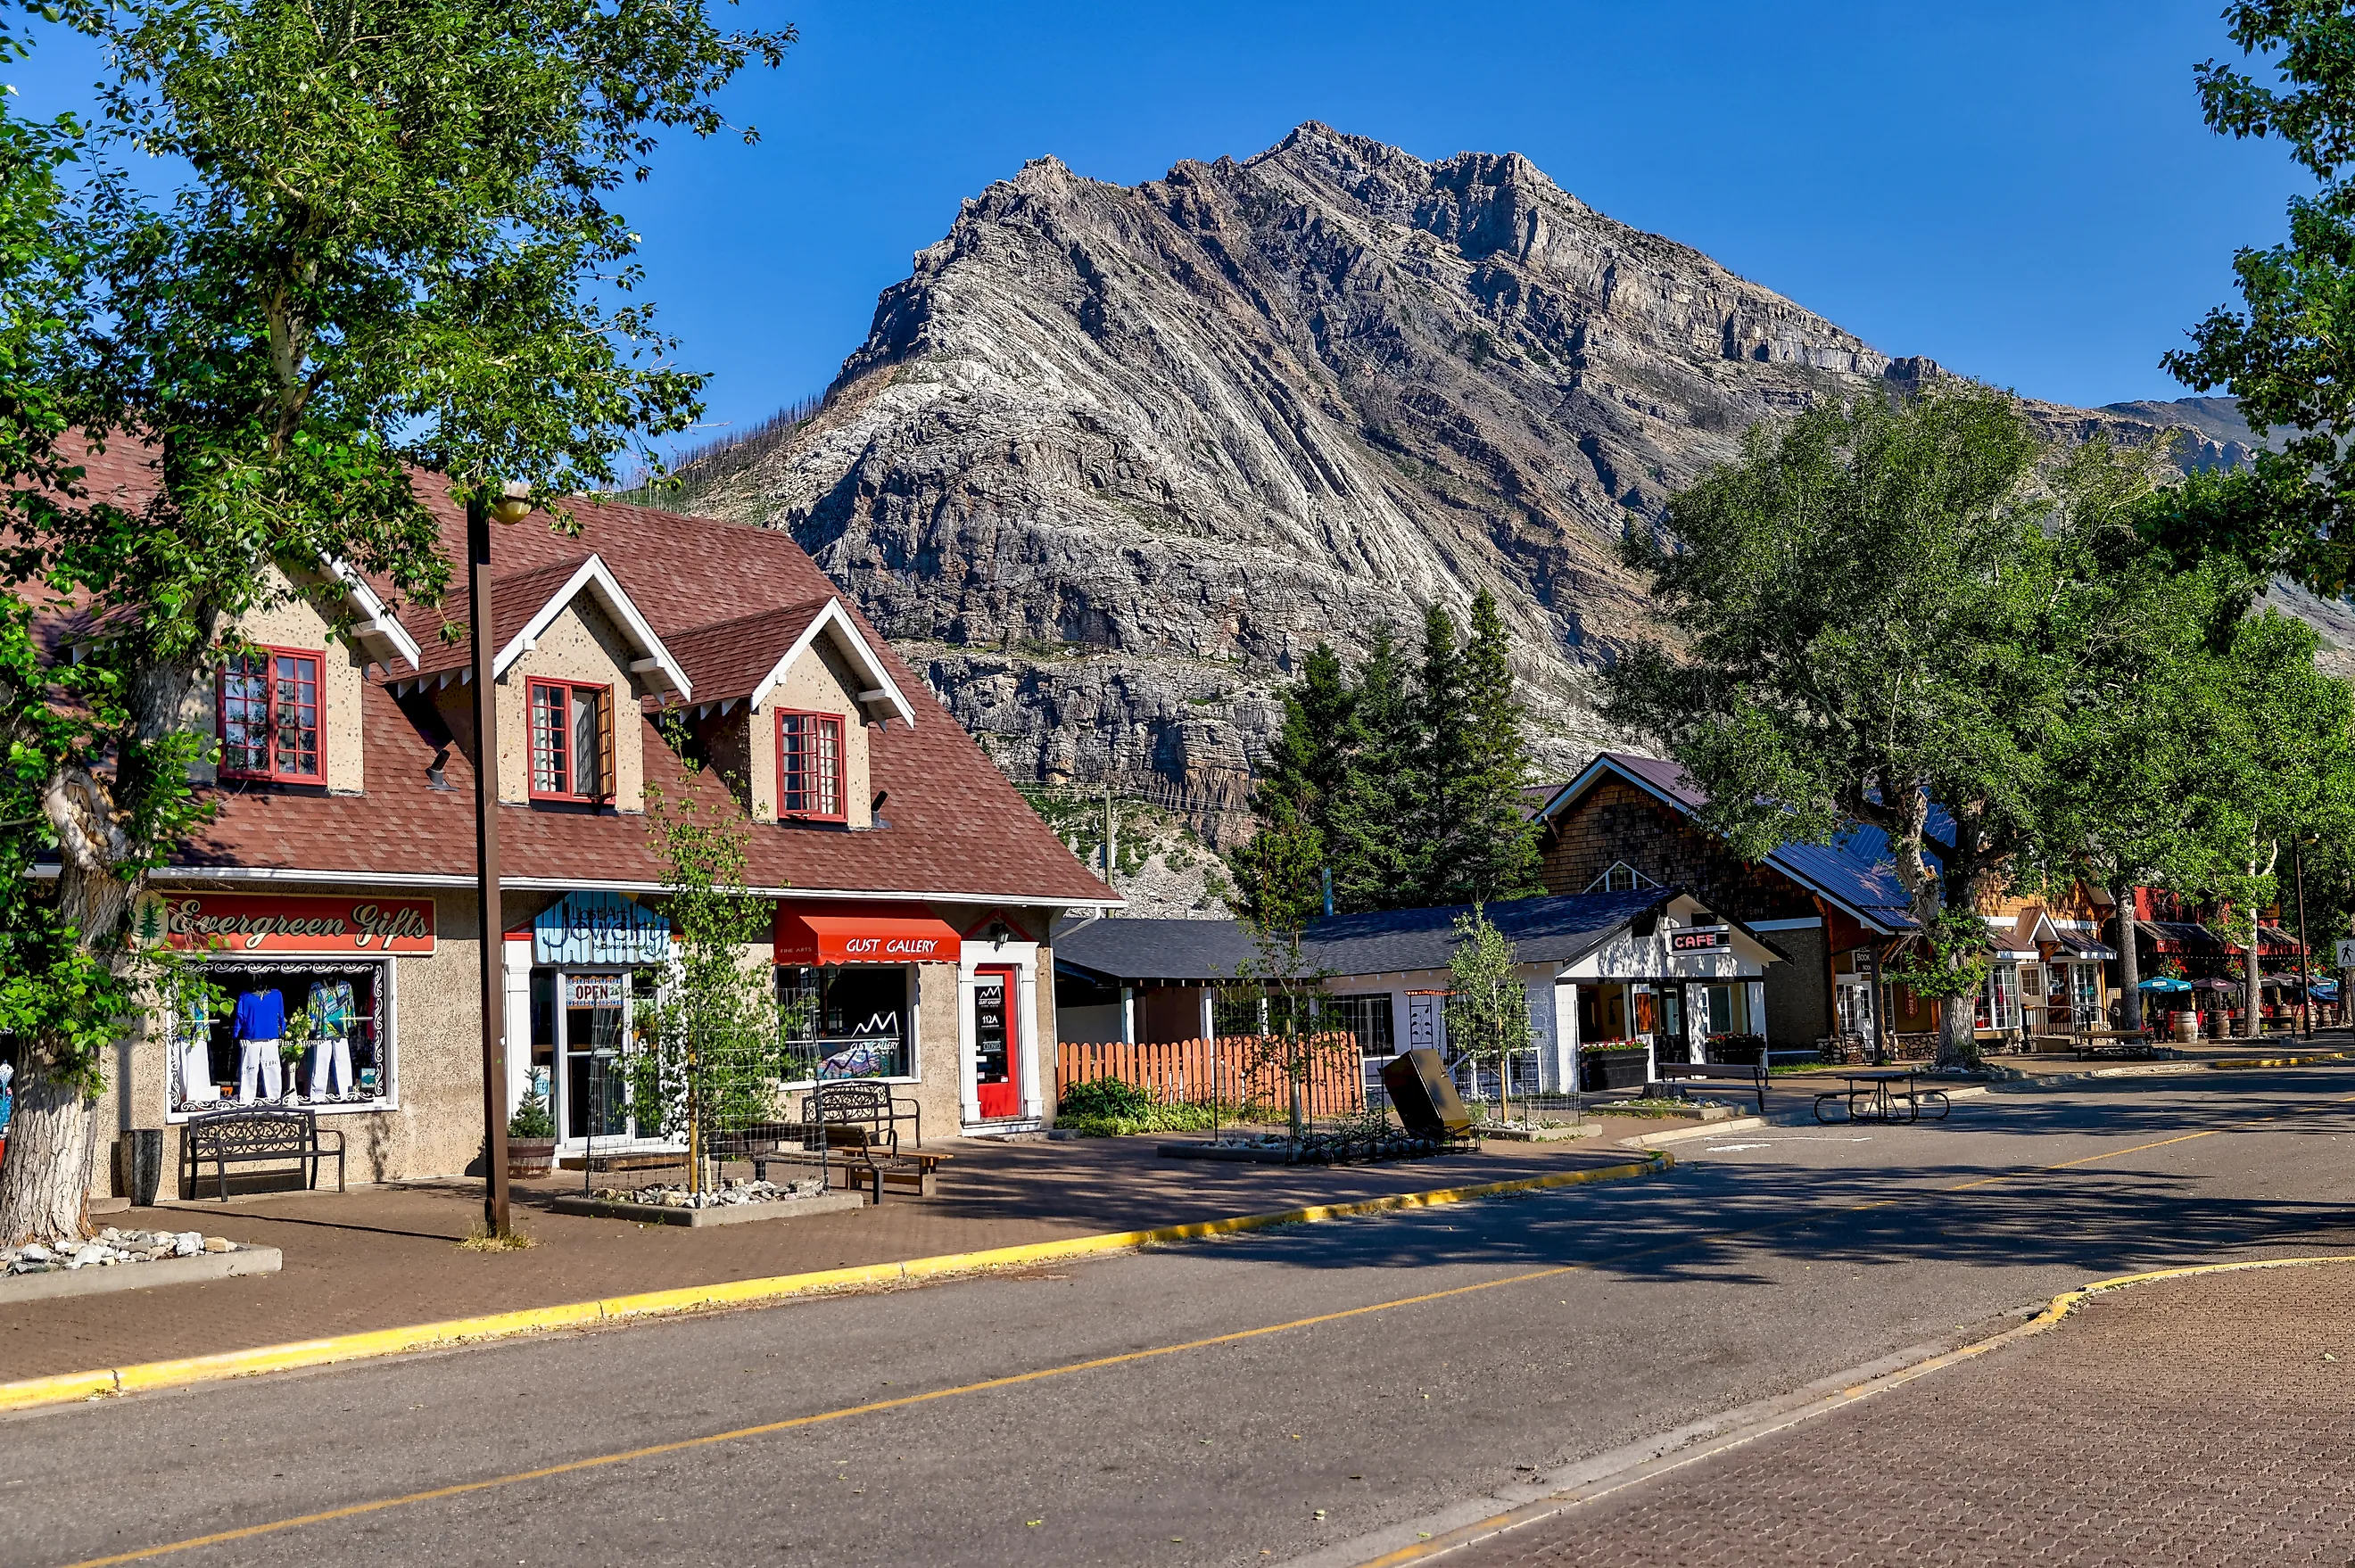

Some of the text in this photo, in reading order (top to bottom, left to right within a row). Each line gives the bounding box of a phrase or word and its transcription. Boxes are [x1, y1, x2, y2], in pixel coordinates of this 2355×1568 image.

[572, 904, 629, 920] Lost Art
[169, 899, 430, 949] Evergreen Gifts
[542, 902, 664, 956] Jewelry
[846, 938, 938, 953] GUST GALLERY
[1674, 935, 1715, 948] CAFE
[575, 985, 608, 1000] OPEN
[982, 1015, 998, 1024] 112A
[850, 1041, 899, 1051] GUST GALLERY
